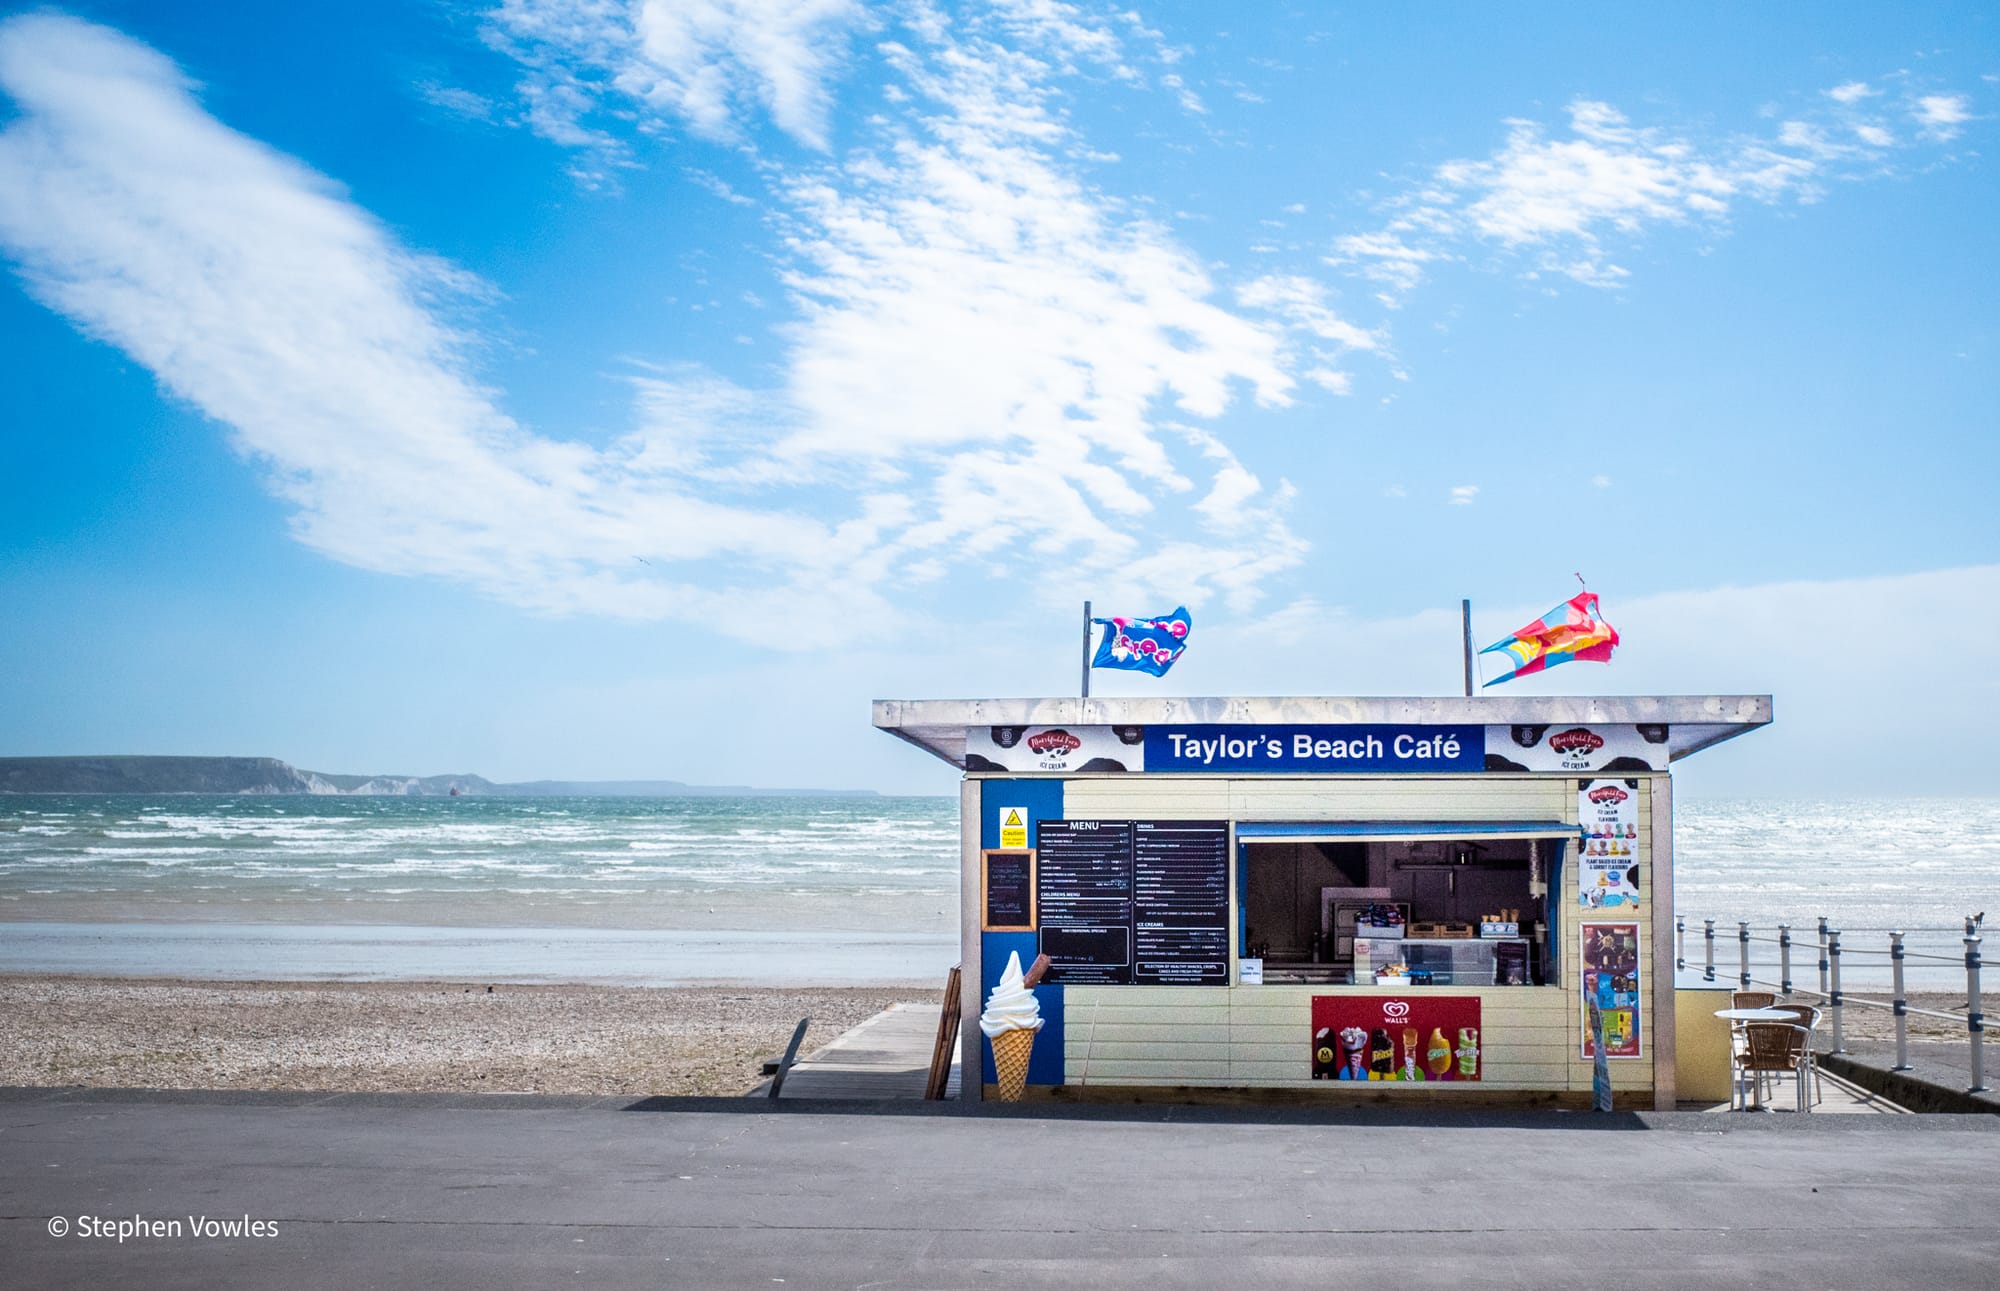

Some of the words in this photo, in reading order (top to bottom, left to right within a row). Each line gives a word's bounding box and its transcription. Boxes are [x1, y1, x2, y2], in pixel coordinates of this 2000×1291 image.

[1293, 733, 1383, 759] Beach
[1394, 732, 1461, 759] Café
[1571, 761, 1591, 770] CREAM
[1069, 821, 1099, 831] MENU
